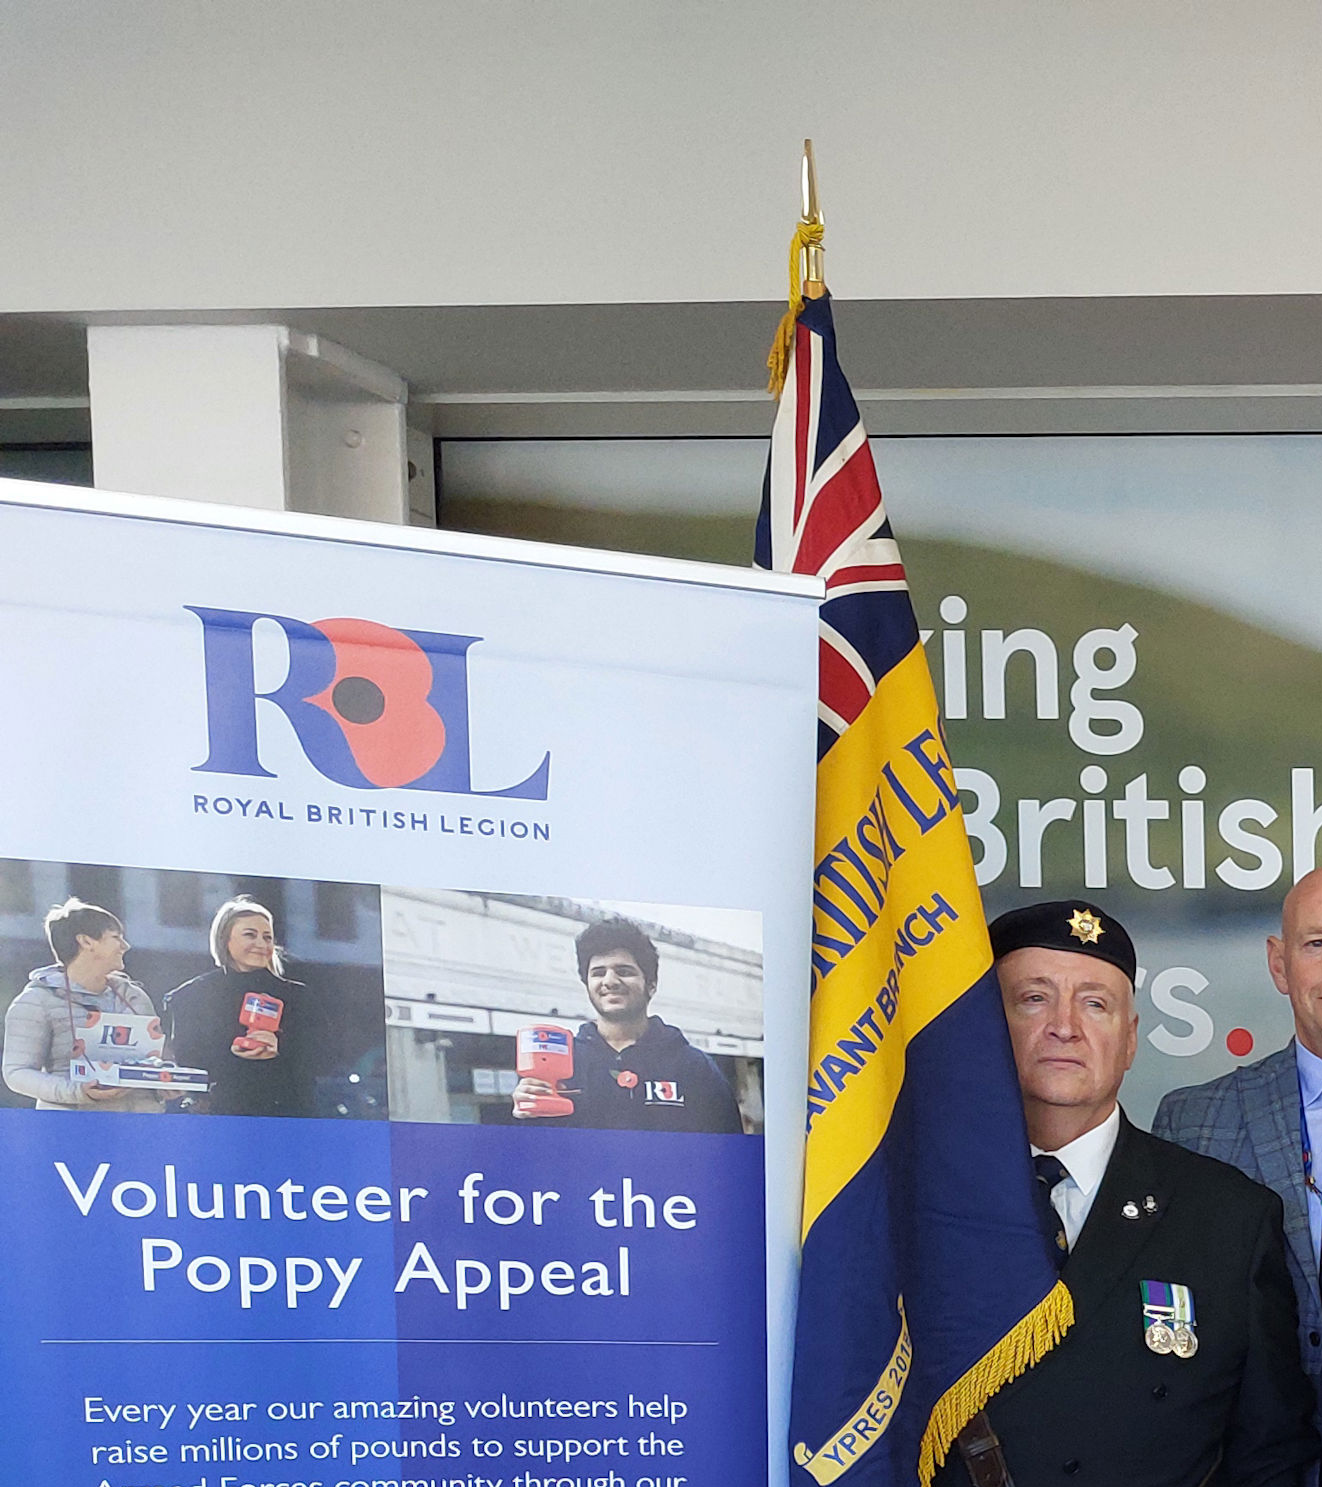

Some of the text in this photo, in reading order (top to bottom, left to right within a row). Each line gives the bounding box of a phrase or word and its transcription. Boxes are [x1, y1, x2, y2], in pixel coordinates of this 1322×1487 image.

[918, 595, 1144, 755] ing
[193, 794, 550, 841] ROYAL BRITISH LEGION
[811, 716, 960, 1000] RITISH LE
[54, 1162, 698, 1230] Volunteer for the
[141, 1238, 630, 1311] Poppy Appeal
[83, 1393, 689, 1431] Every year our amazing volunteers help
[822, 1390, 893, 1466] YPRES
[91, 1432, 685, 1467] raise millions of pounds to support the
